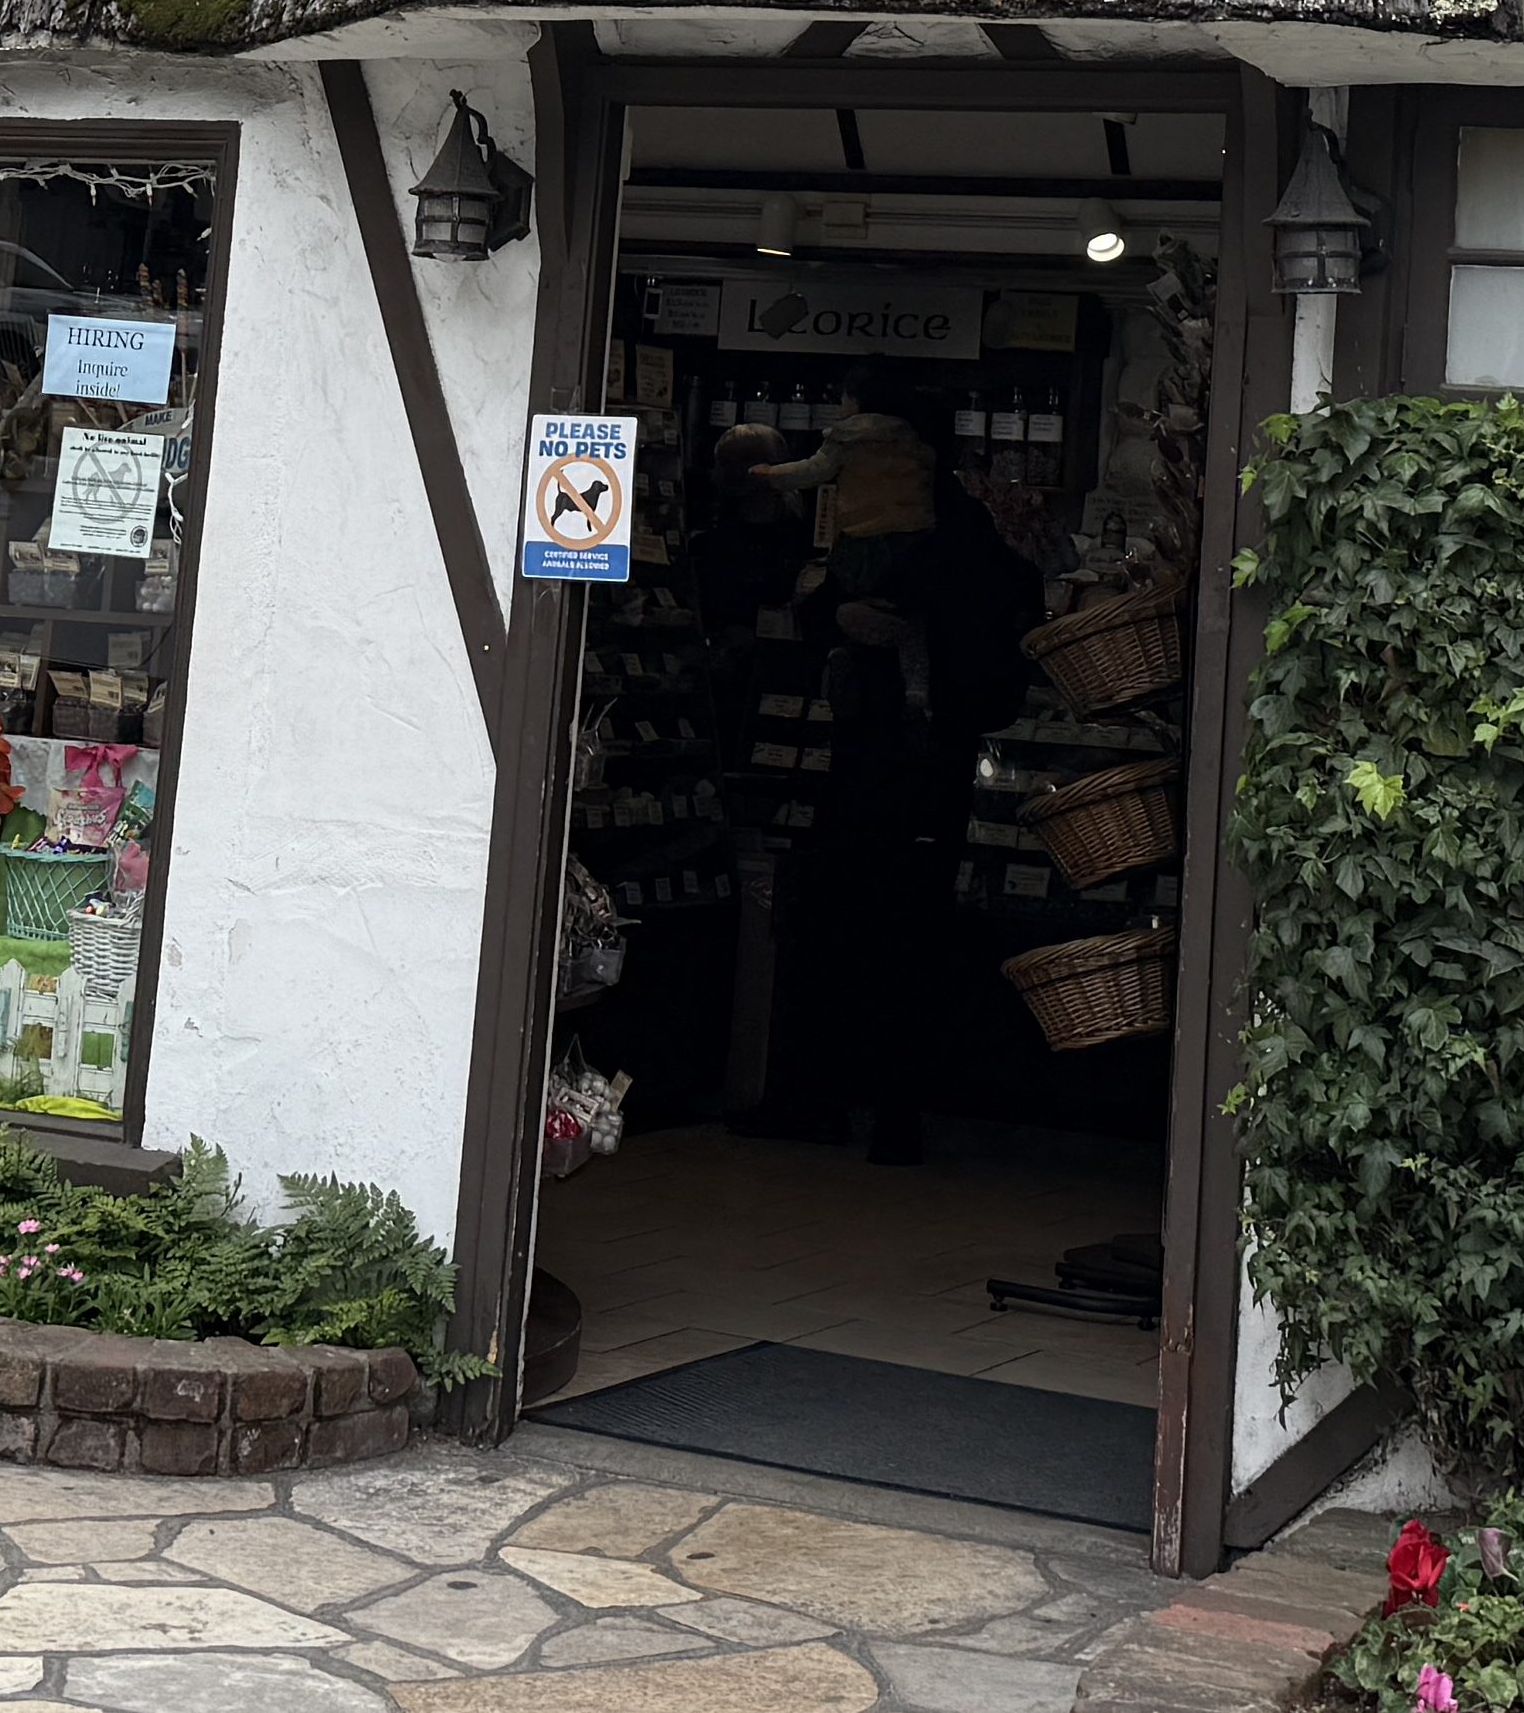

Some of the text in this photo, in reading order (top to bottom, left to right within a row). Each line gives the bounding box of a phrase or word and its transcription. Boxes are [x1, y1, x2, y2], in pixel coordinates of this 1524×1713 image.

[67, 326, 145, 351] HIRING
[77, 359, 128, 379] Inquire
[76, 380, 121, 398] inside!
[145, 410, 173, 426] MAKE
[545, 421, 622, 440] PLEASE
[539, 440, 627, 460] NO PETS
[579, 551, 609, 561] SERVICE
